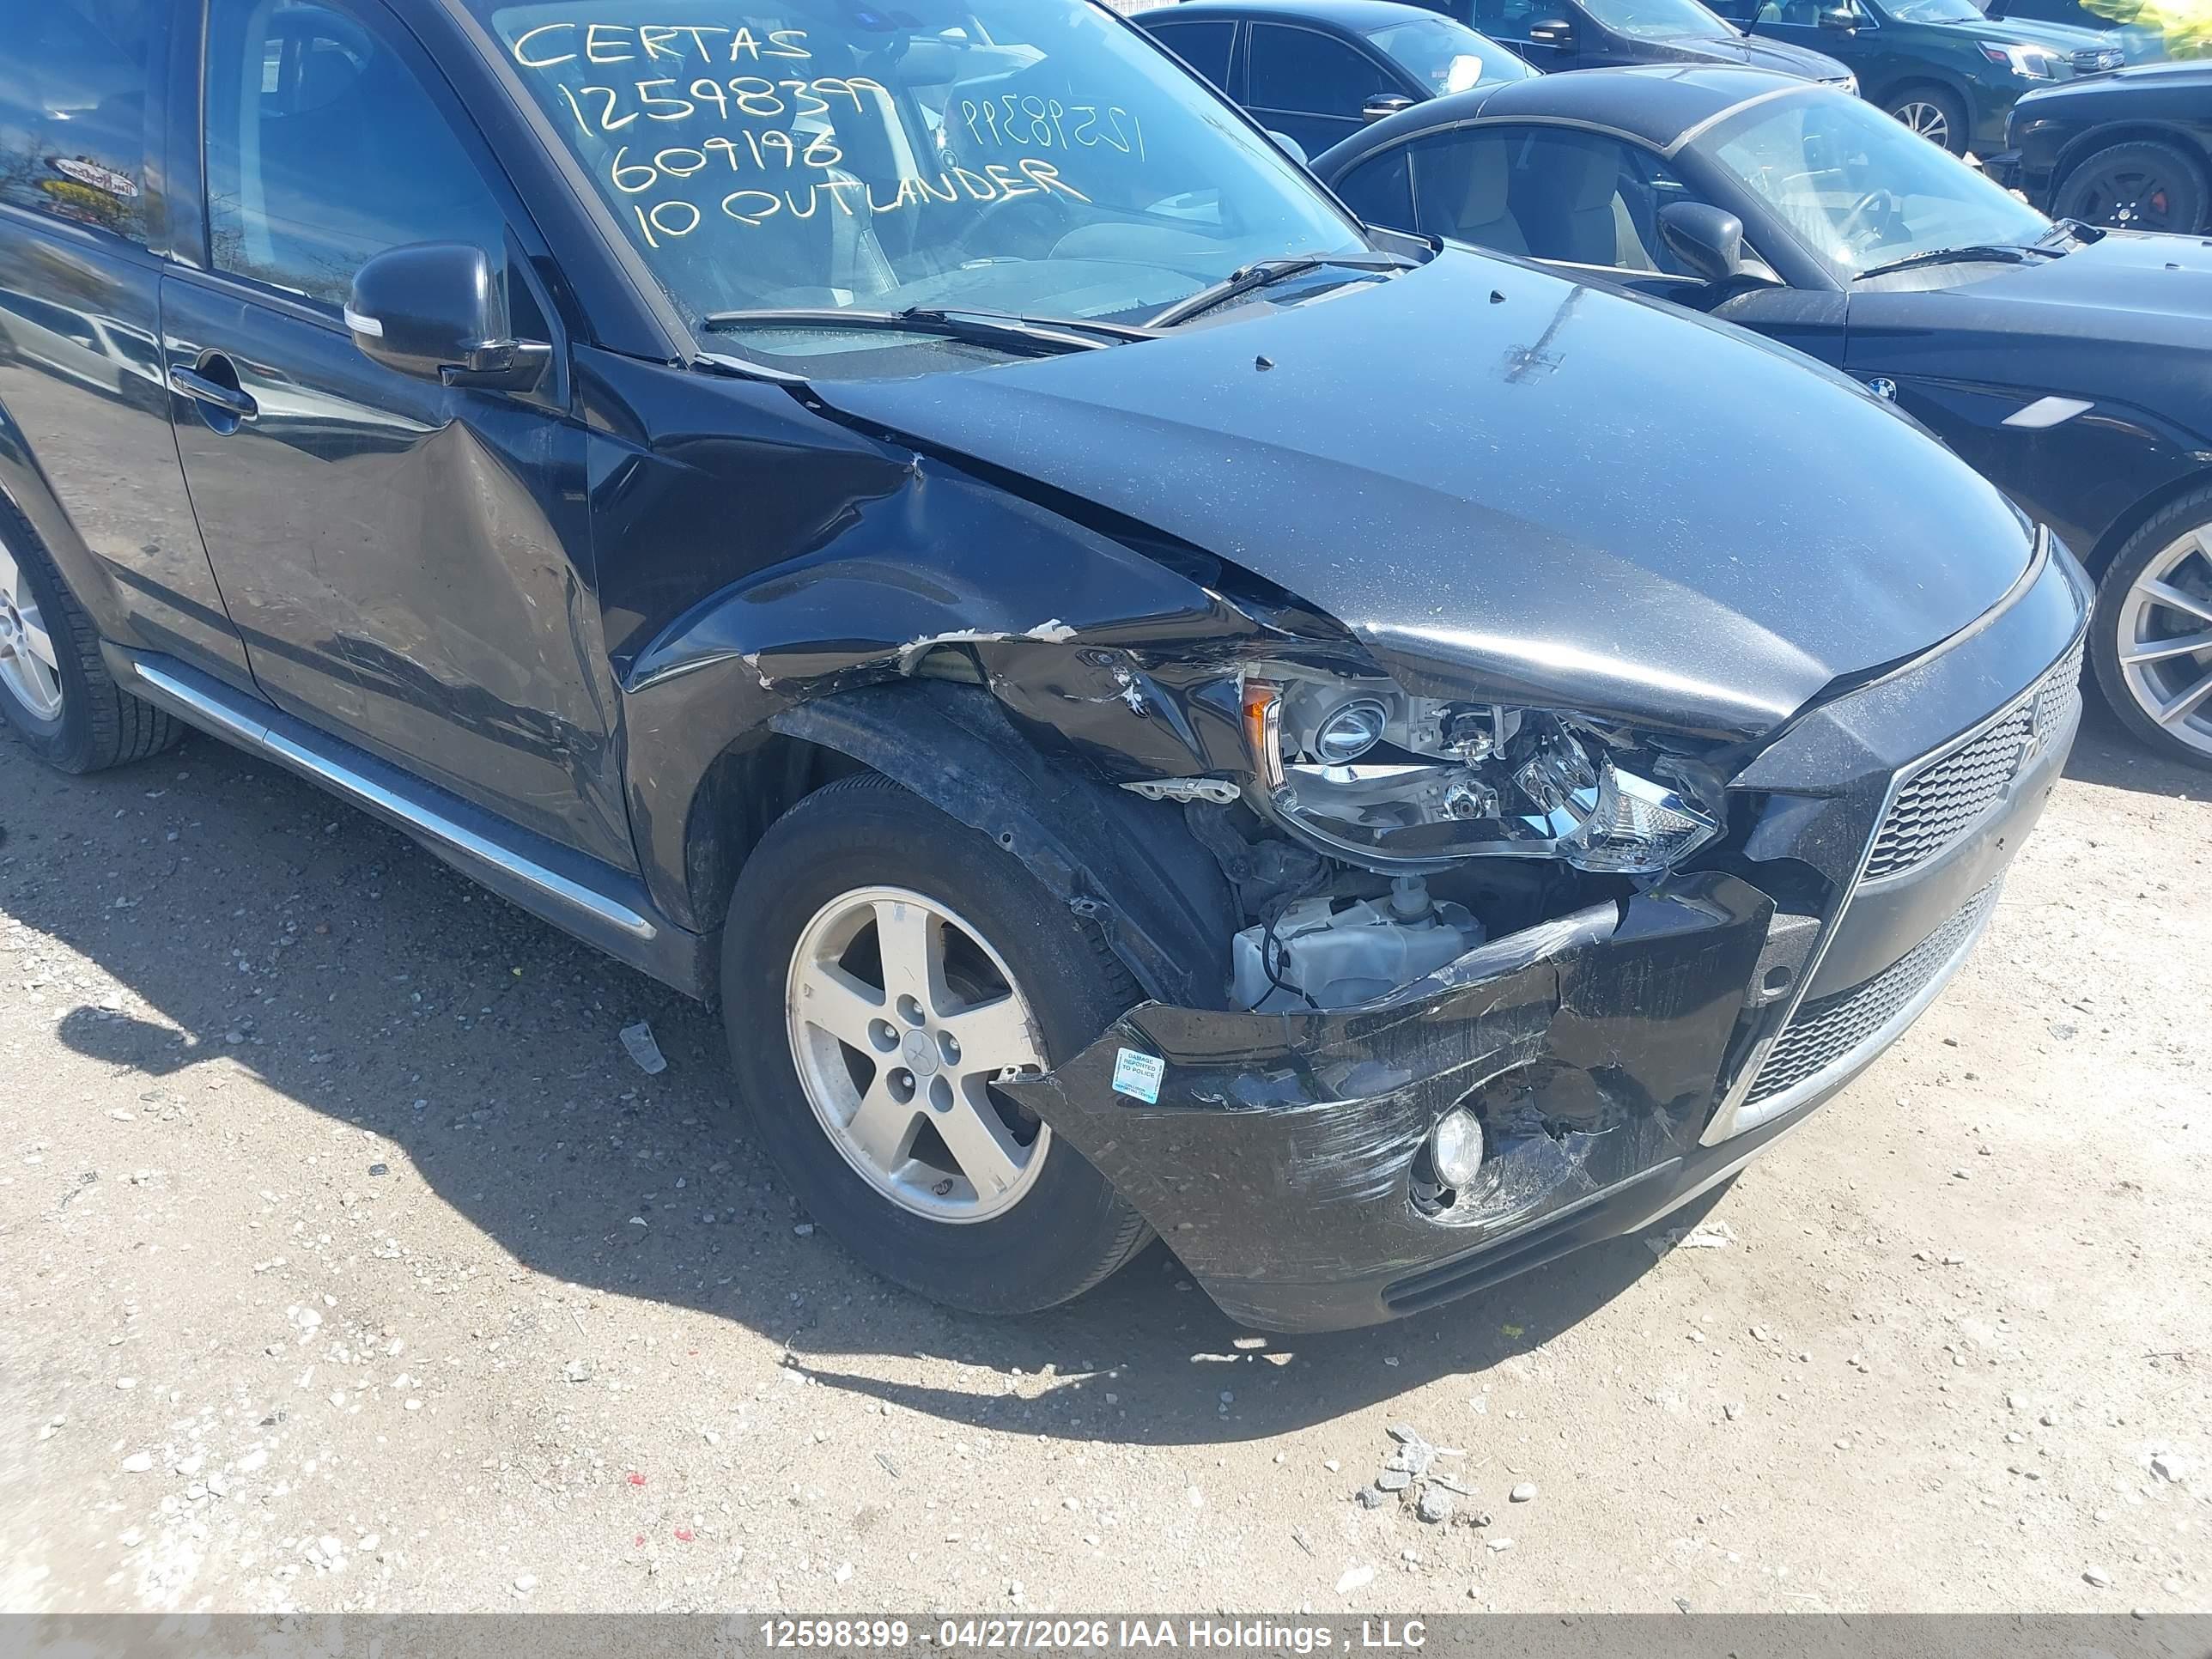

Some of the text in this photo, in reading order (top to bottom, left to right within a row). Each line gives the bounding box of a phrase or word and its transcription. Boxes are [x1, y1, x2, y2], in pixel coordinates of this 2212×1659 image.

[514, 23, 812, 67] CERTAS
[557, 76, 896, 137] 12598399
[612, 128, 843, 193] 609196
[634, 158, 1094, 248] 10 OUTLANDER
[1123, 1058, 1156, 1072] REPORTED
[1128, 1053, 1154, 1065] DAMAGE
[1132, 1067, 1155, 1079] POLICE
